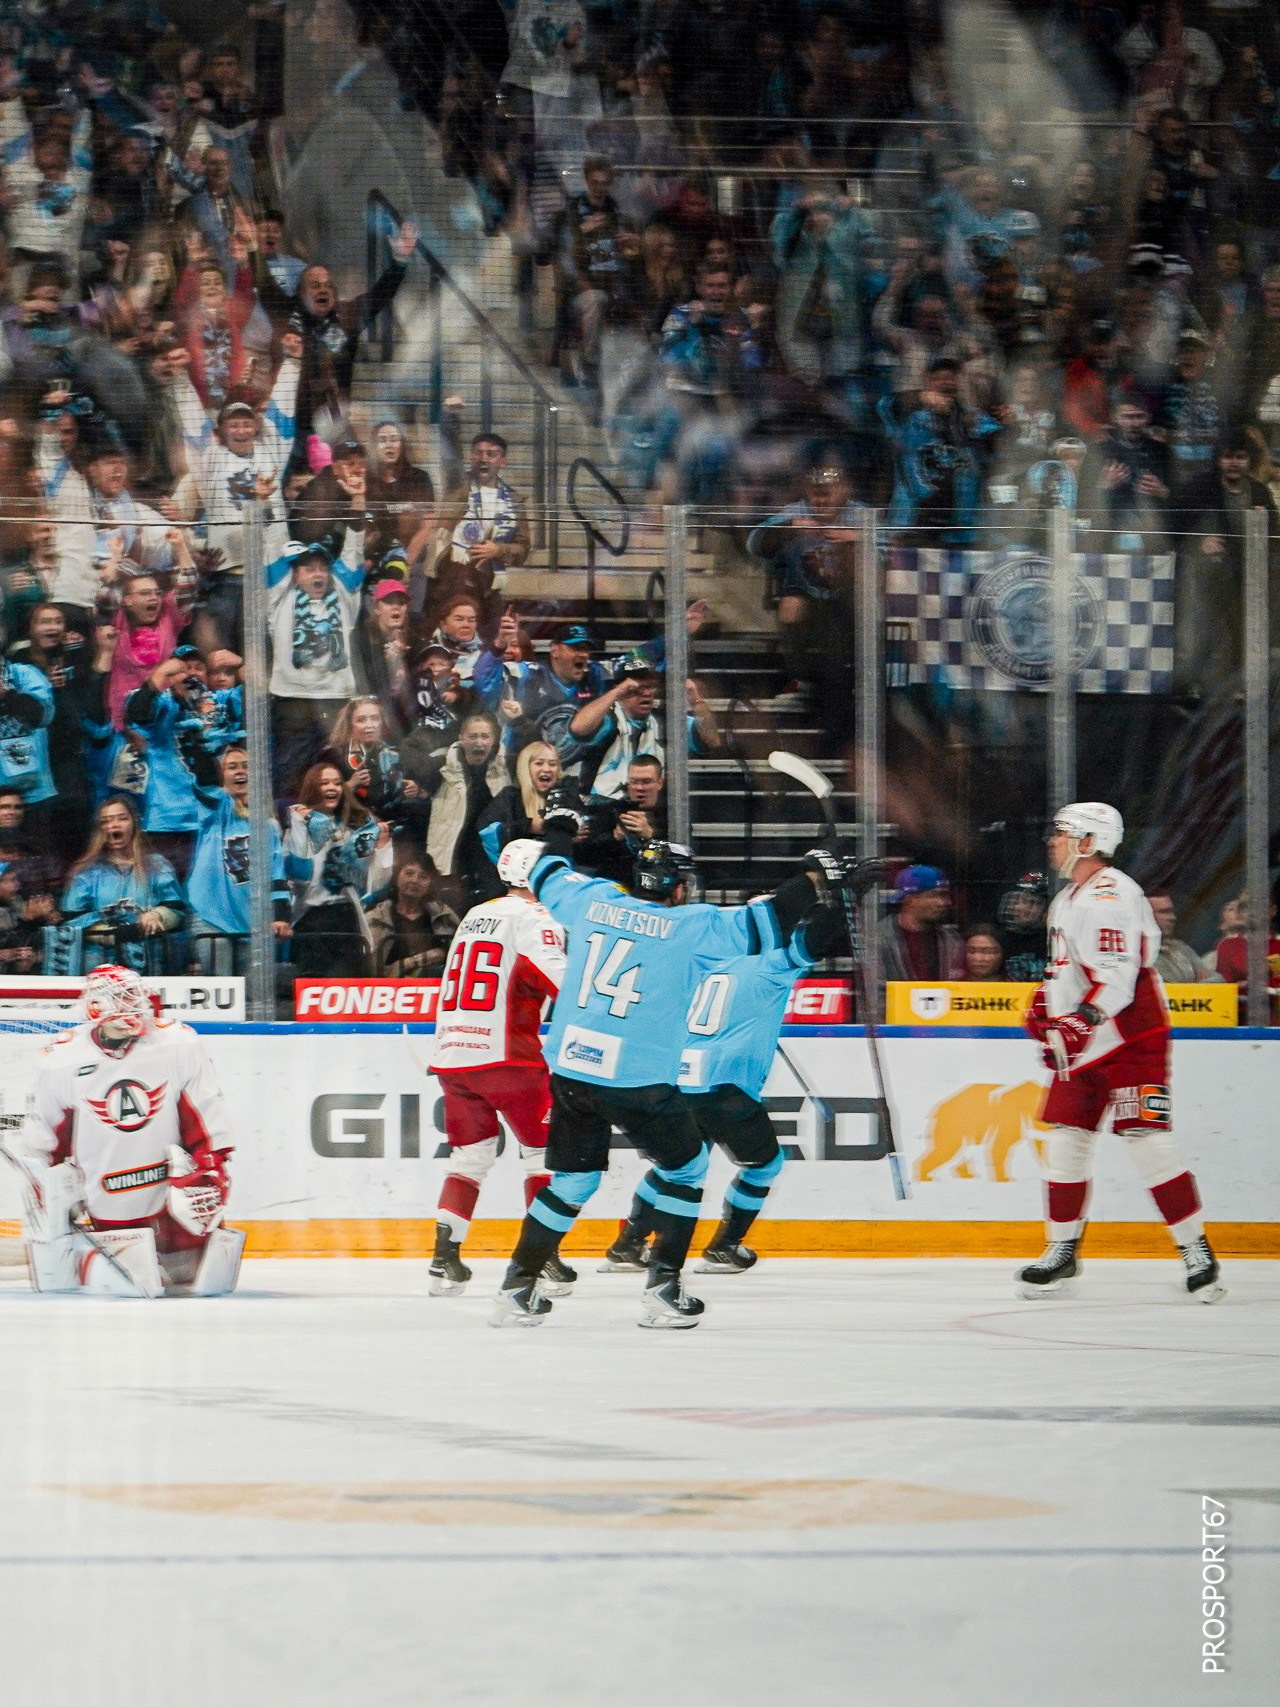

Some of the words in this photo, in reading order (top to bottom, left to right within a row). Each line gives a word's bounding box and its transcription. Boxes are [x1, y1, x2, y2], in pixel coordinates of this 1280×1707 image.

[577, 931, 642, 1019] 14
[157, 987, 236, 1010] L.RU
[298, 986, 440, 1015] FONBET
[686, 973, 731, 1036] 0
[1166, 998, 1213, 1012] АНК
[104, 1166, 167, 1191] WINLINE
